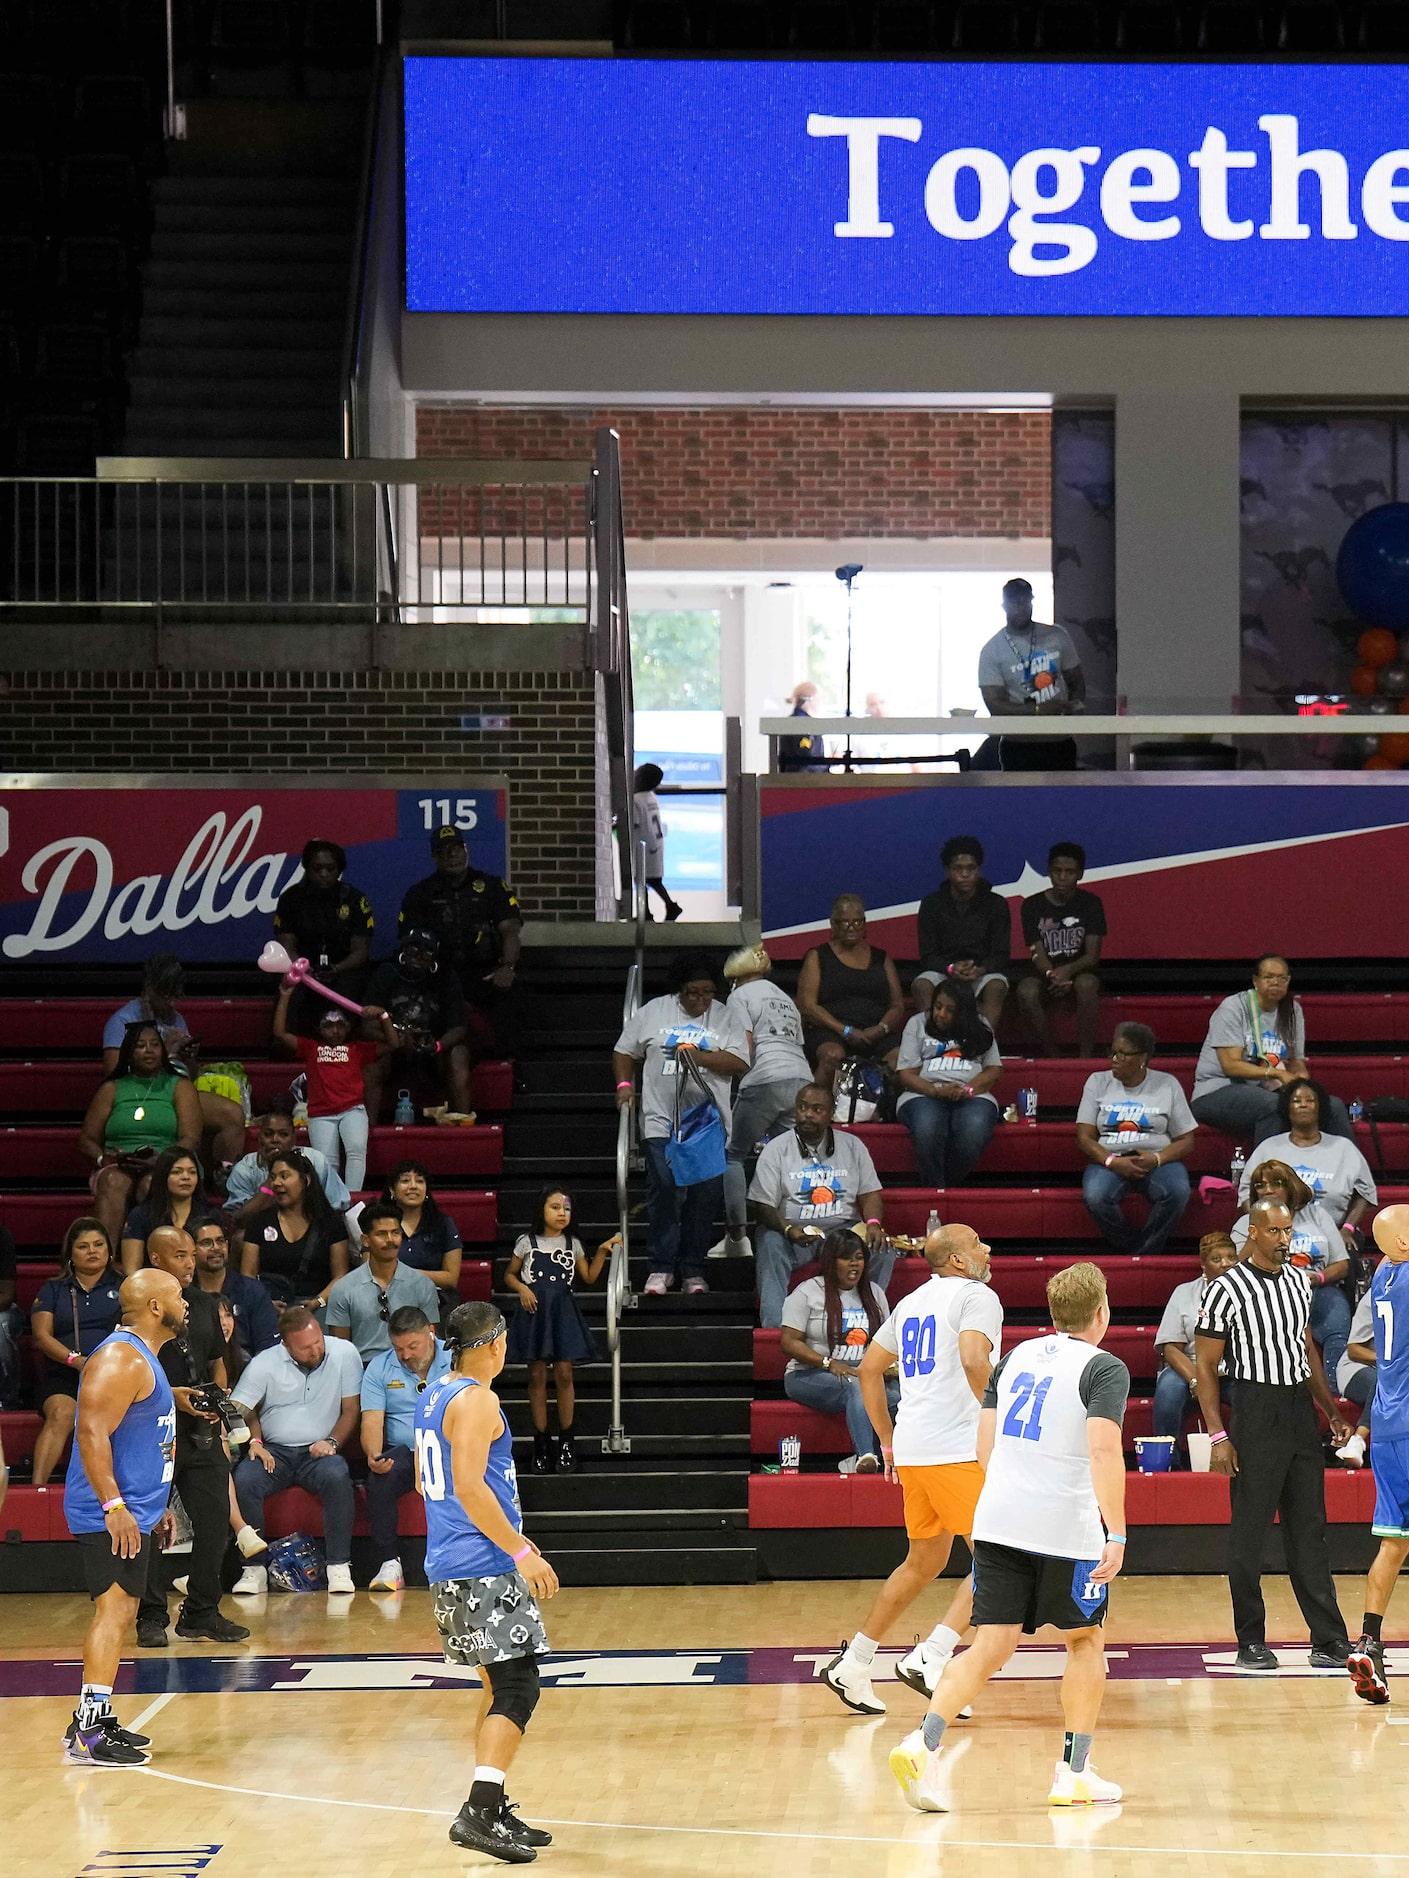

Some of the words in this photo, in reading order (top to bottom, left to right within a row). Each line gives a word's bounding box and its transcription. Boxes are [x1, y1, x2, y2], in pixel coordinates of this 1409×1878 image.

[418, 798, 478, 830] 115
[2, 805, 306, 958] Dalla
[927, 1056, 973, 1072] BALL
[789, 1169, 848, 1181] TOGETHER
[799, 1201, 844, 1220] BALL
[902, 1315, 936, 1378] 80
[1002, 1371, 1054, 1442] 21
[781, 1442, 801, 1458] PON
